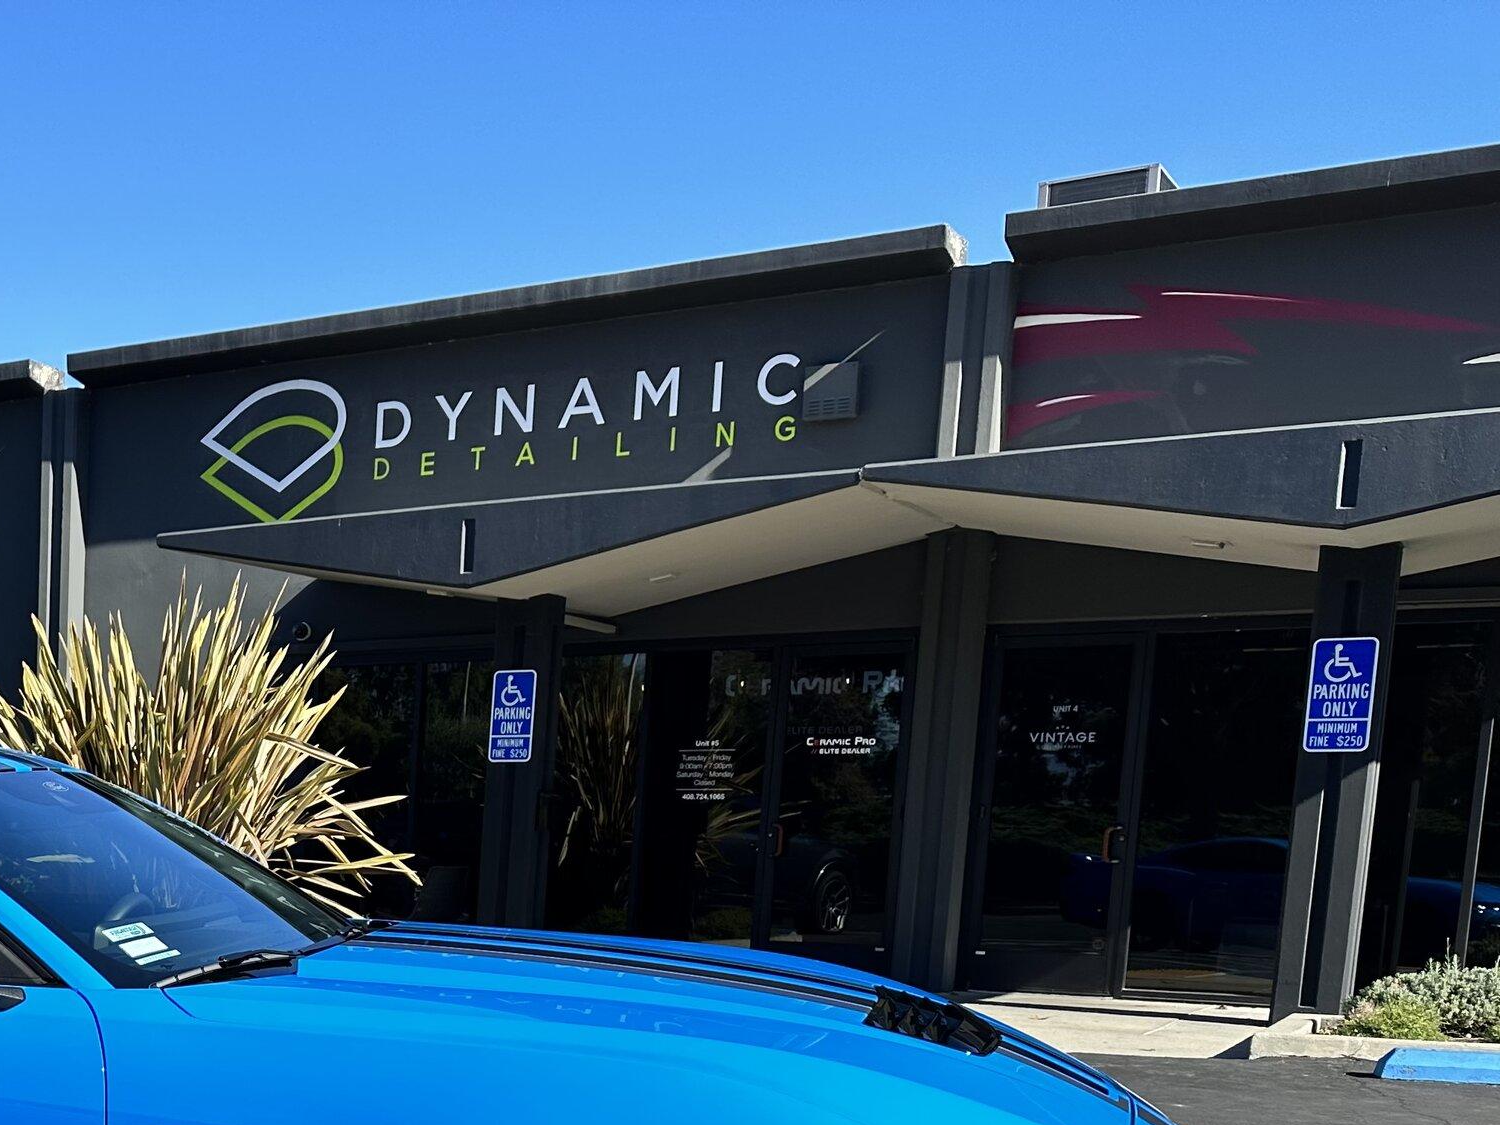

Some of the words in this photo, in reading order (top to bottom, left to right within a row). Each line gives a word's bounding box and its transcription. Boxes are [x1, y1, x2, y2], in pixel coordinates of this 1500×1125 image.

[375, 353, 801, 449] DYNAMIC
[373, 415, 797, 481] DETAILING
[1313, 683, 1370, 699] PARKING
[494, 707, 531, 720] PARKING
[1323, 702, 1357, 717] ONLY
[501, 722, 523, 734] ONLY
[1317, 723, 1358, 733] MINIMUM
[497, 739, 524, 747] MINIMUM
[1029, 732, 1097, 743] VINTAGE
[1309, 736, 1329, 746] FINE
[1336, 735, 1362, 746] $250
[510, 749, 527, 758] $250
